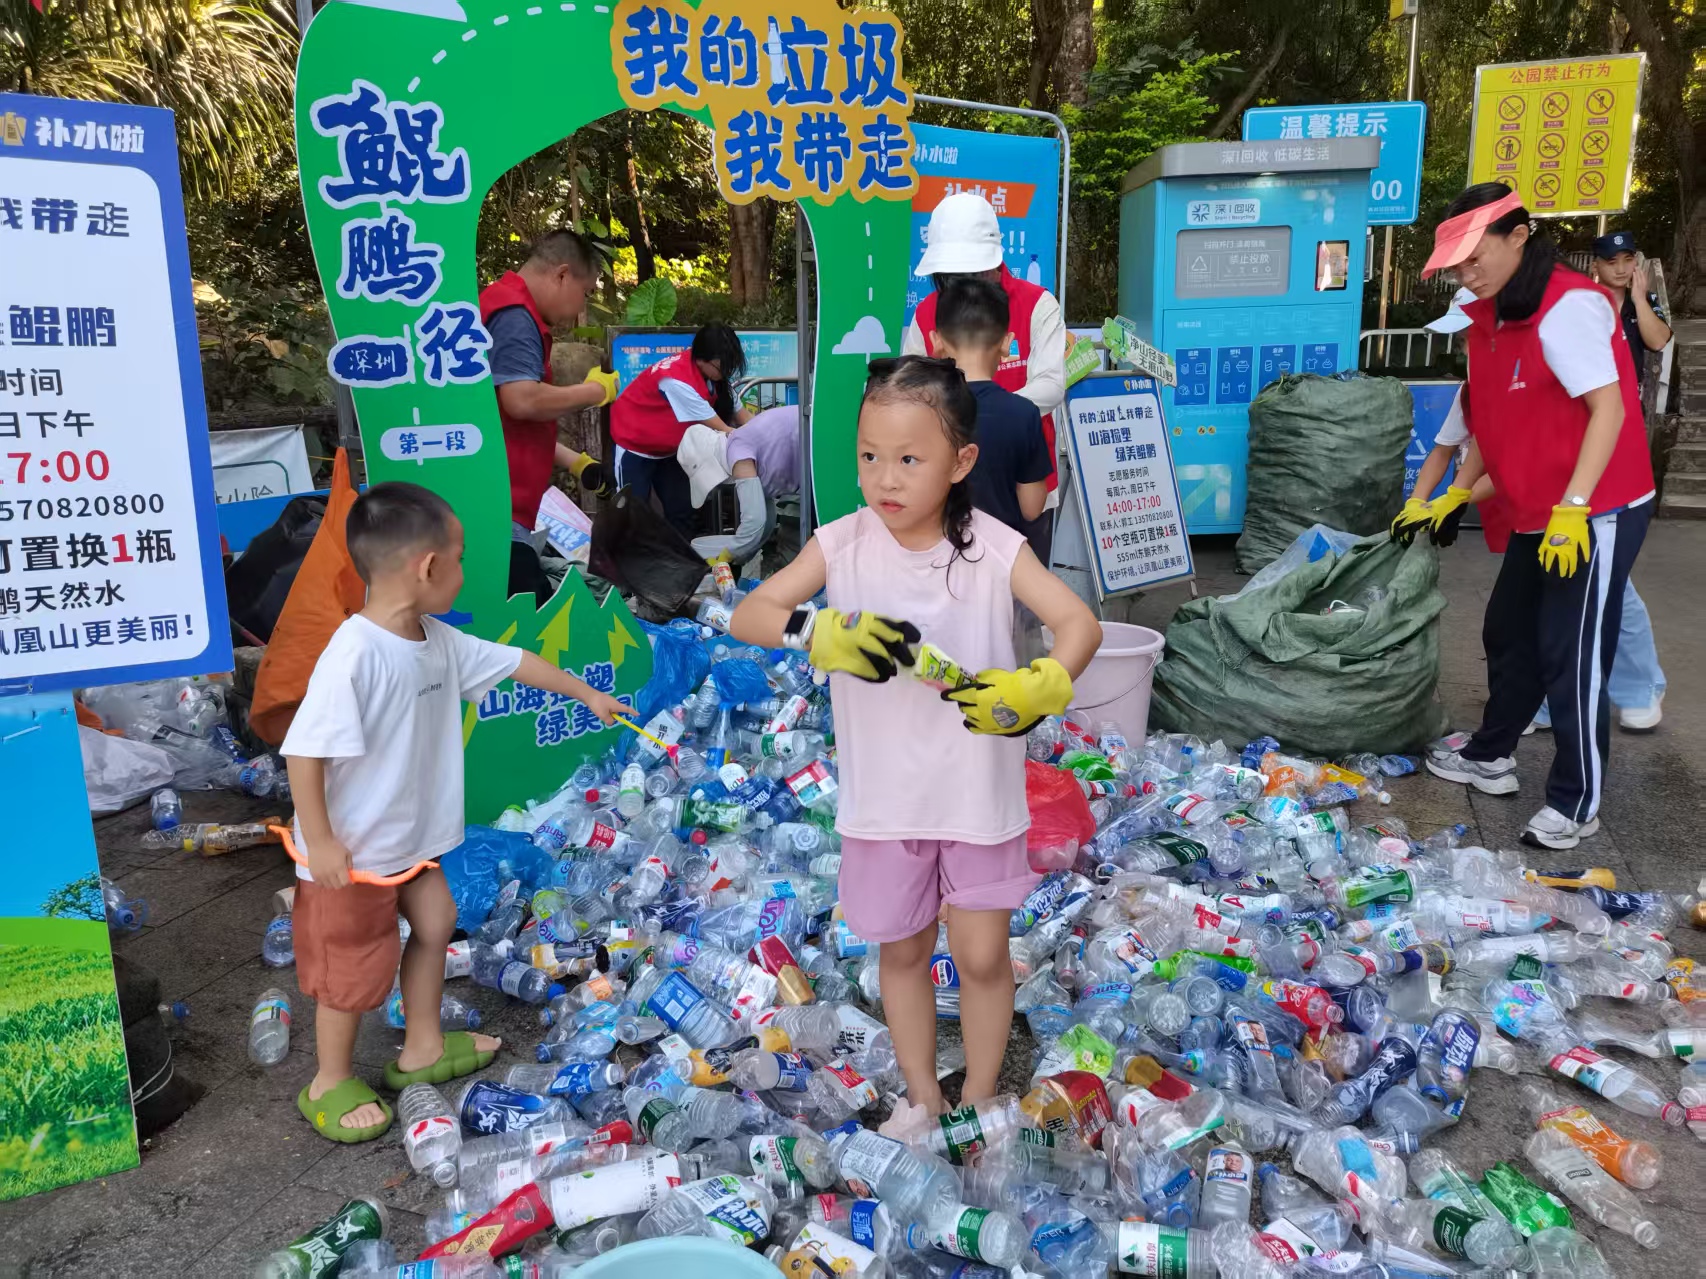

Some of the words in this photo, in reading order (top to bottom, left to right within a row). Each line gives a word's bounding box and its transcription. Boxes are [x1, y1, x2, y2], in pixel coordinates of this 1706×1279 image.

[623, 5, 908, 106] 我的垃圾
[1510, 62, 1612, 84] 公园禁止行为
[35, 117, 145, 153] 补水啦
[1280, 112, 1389, 138] 温馨提示
[725, 108, 912, 193] 我带走
[1274, 146, 1330, 161] 低碳生活
[0, 304, 117, 347] 鲲鹏
[348, 348, 397, 373] 深圳
[1079, 409, 1117, 425] 我的垃圾
[1126, 406, 1154, 420] 我带走
[398, 429, 467, 457] 第一段
[1088, 427, 1133, 447] 山海捡塑
[1115, 443, 1157, 463] 绿美鲲鹏
[0, 449, 110, 485] 7:00
[1108, 466, 1150, 482] 志愿服务时间
[1107, 495, 1162, 516] 14:00-17:00
[1101, 523, 1179, 550] 10个空瓶可置换1瓶
[478, 663, 616, 720] 山海塑
